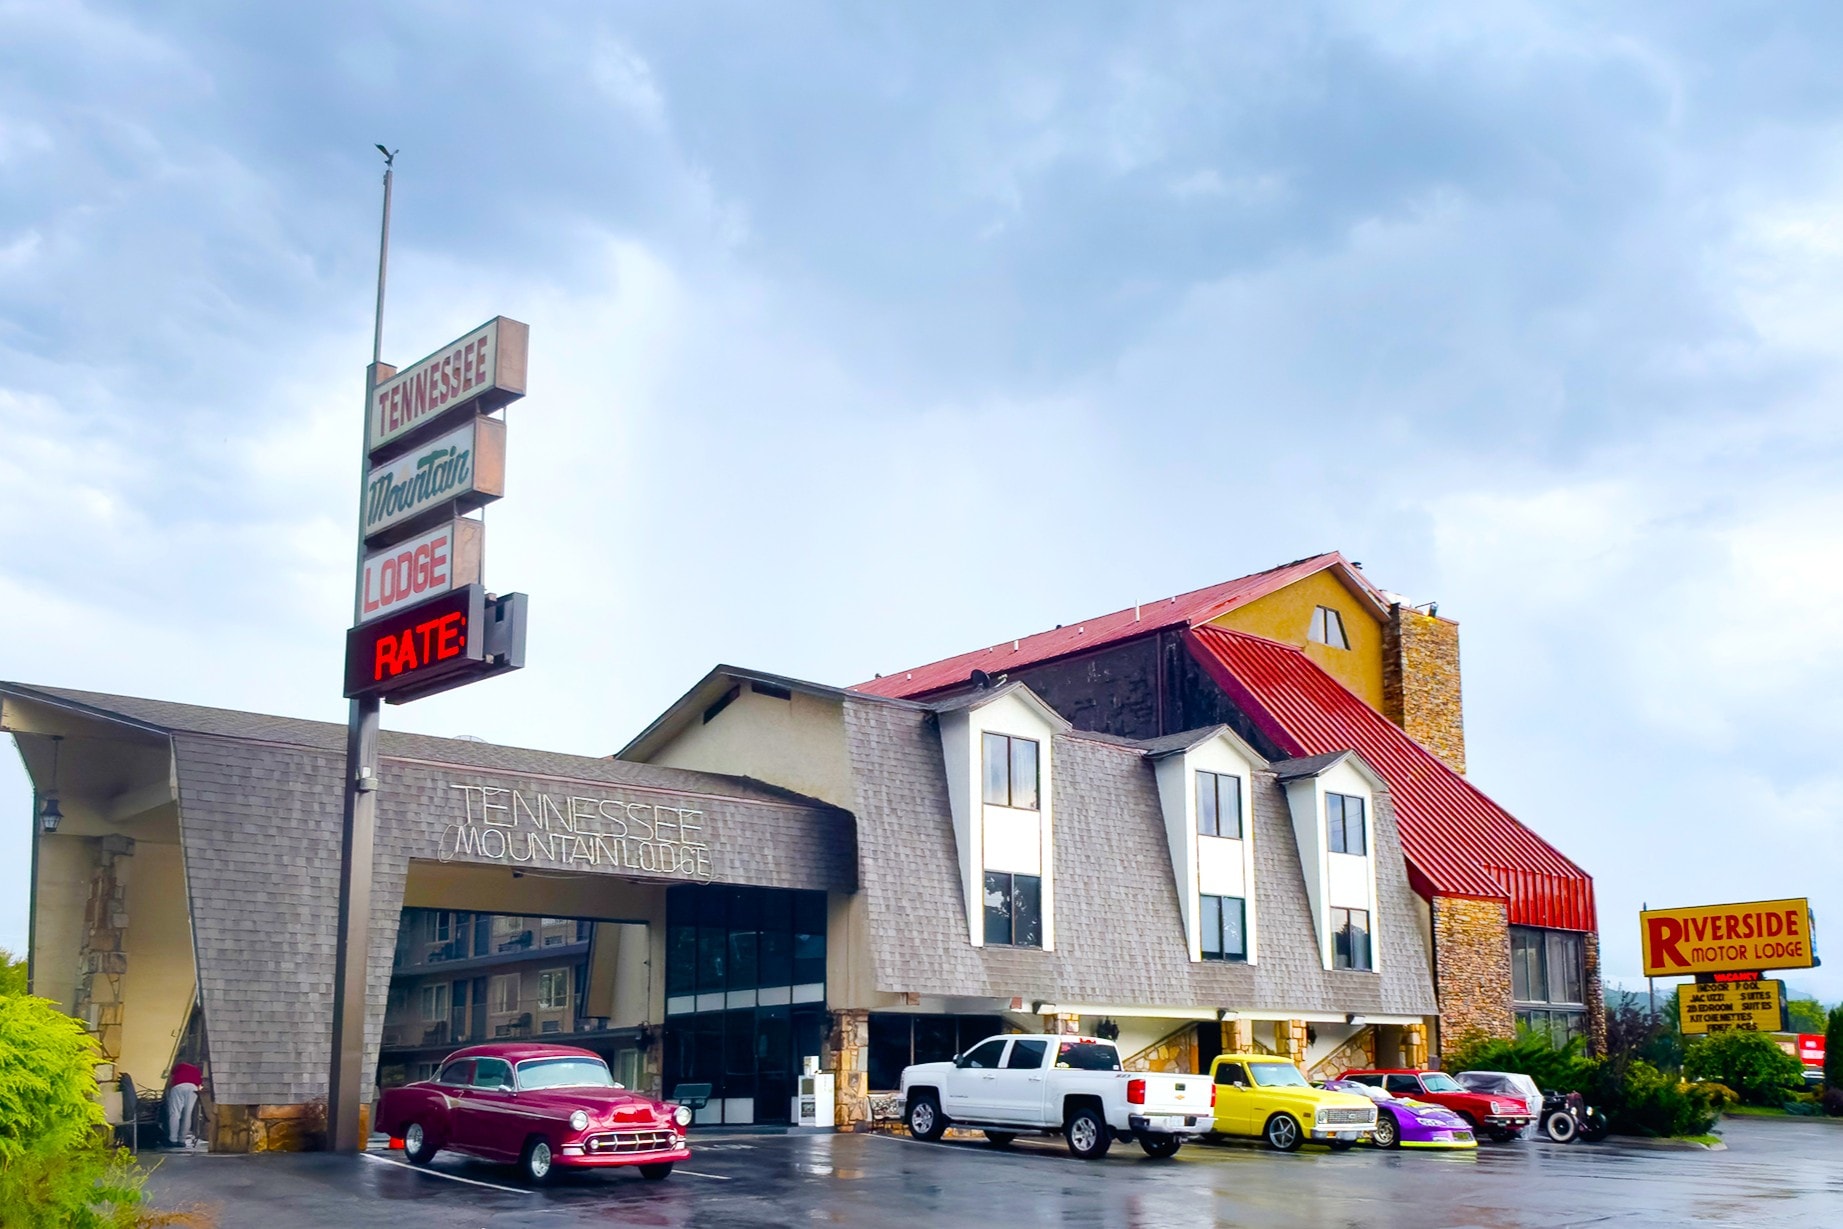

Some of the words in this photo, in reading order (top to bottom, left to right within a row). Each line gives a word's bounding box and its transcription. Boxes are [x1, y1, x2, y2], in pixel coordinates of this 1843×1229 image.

[379, 335, 488, 437] TENNESSEE
[367, 446, 470, 526] Mountain
[364, 535, 448, 613] LODGE
[450, 784, 706, 847] TENNESSEE
[1692, 944, 1747, 962] MOTOR
[1754, 941, 1803, 959] LODGE
[1735, 981, 1760, 991] POOL
[1740, 991, 1771, 1001] SUITES
[1741, 1002, 1772, 1011] SUITES
